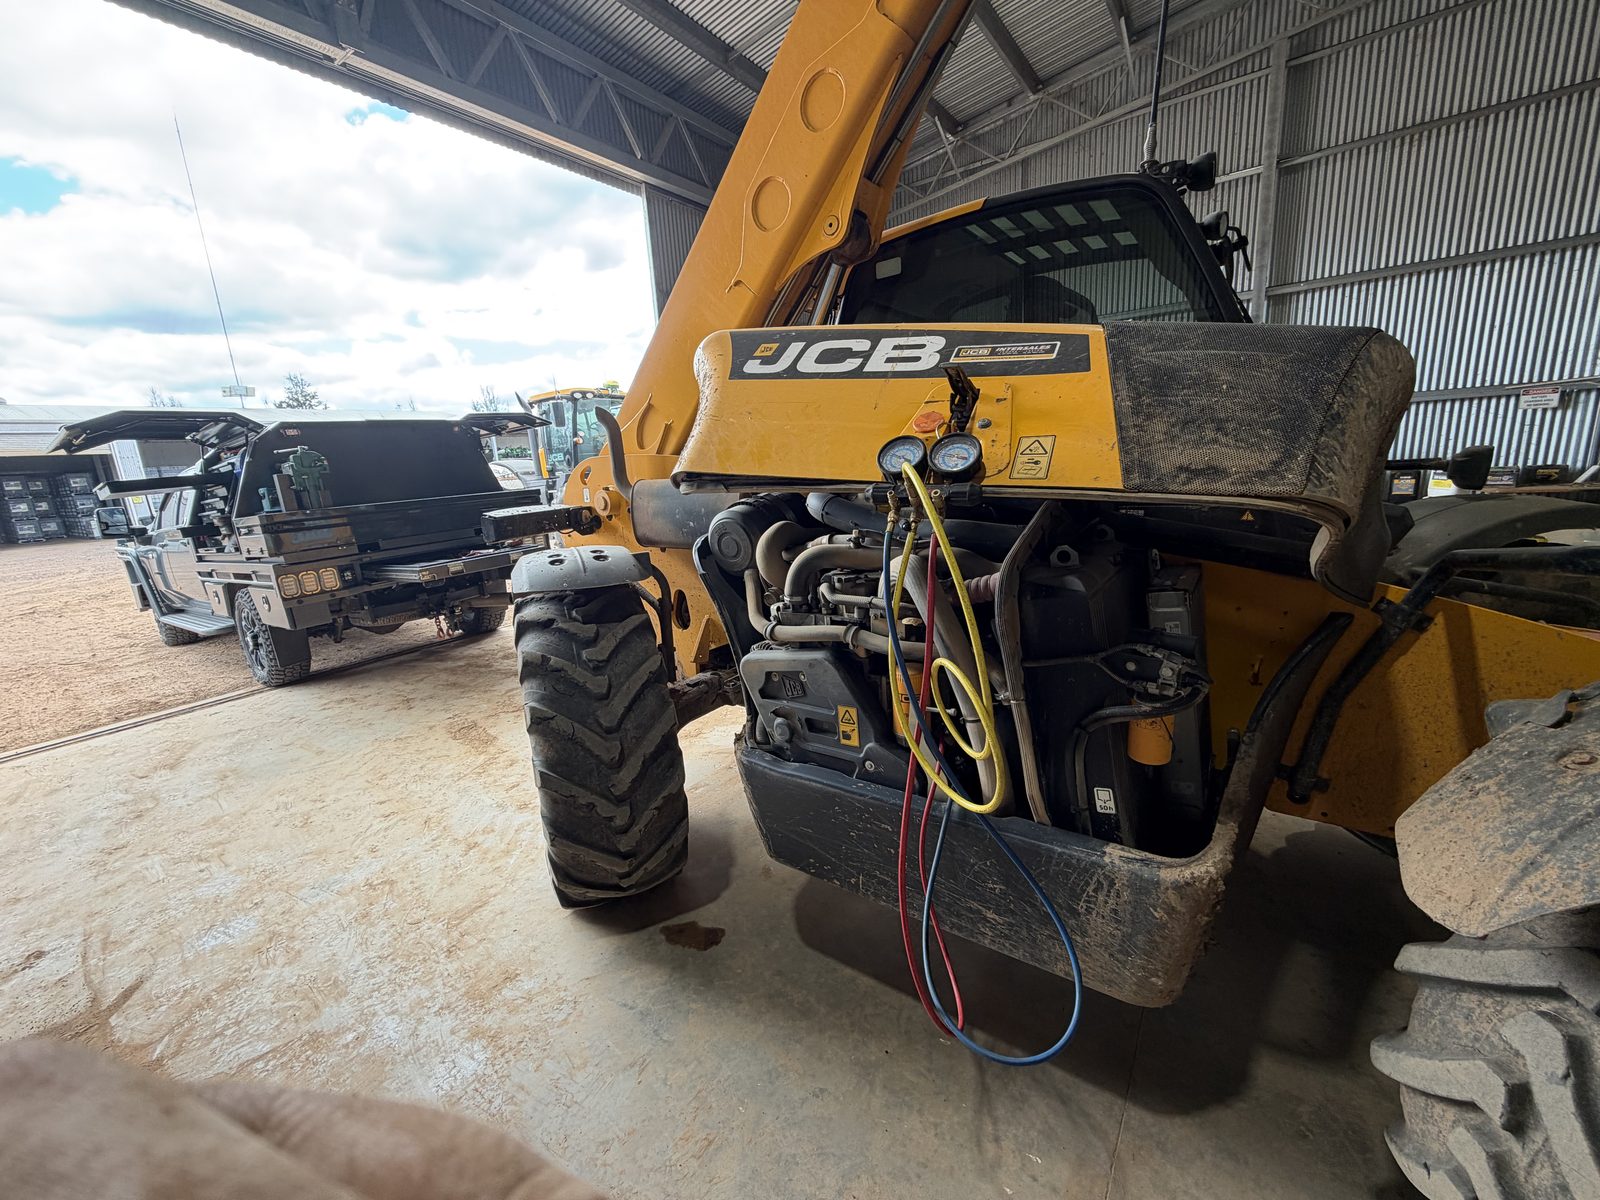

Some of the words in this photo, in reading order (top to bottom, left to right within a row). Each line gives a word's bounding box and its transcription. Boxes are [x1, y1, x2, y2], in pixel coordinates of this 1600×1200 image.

[742, 335, 946, 373] JCB
[962, 348, 988, 356] JCB
[995, 344, 1052, 352] INTERSALES
[548, 453, 564, 461] JCB
[785, 679, 804, 697] JCB
